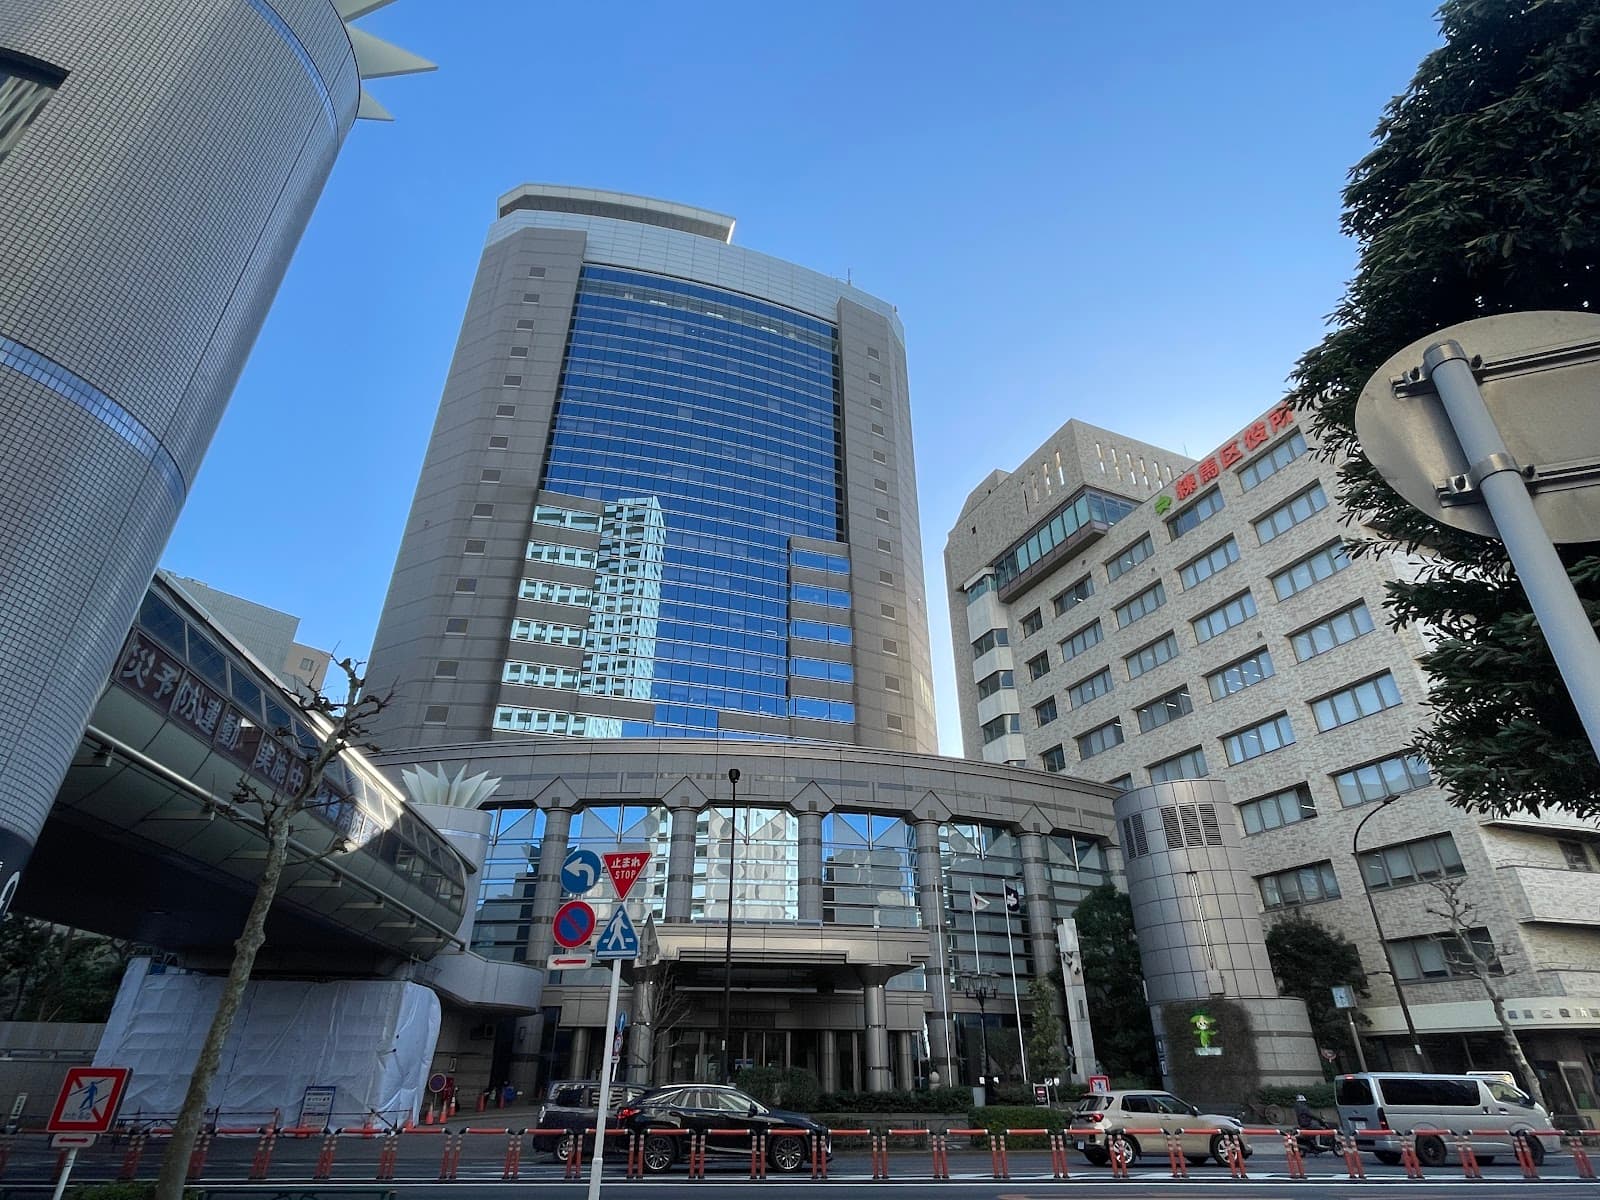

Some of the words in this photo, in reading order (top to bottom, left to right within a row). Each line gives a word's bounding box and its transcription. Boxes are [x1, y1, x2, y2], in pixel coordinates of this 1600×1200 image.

[1175, 399, 1294, 501] 練馬区役所
[611, 857, 641, 868] 止まれ
[615, 871, 636, 880] STOP
